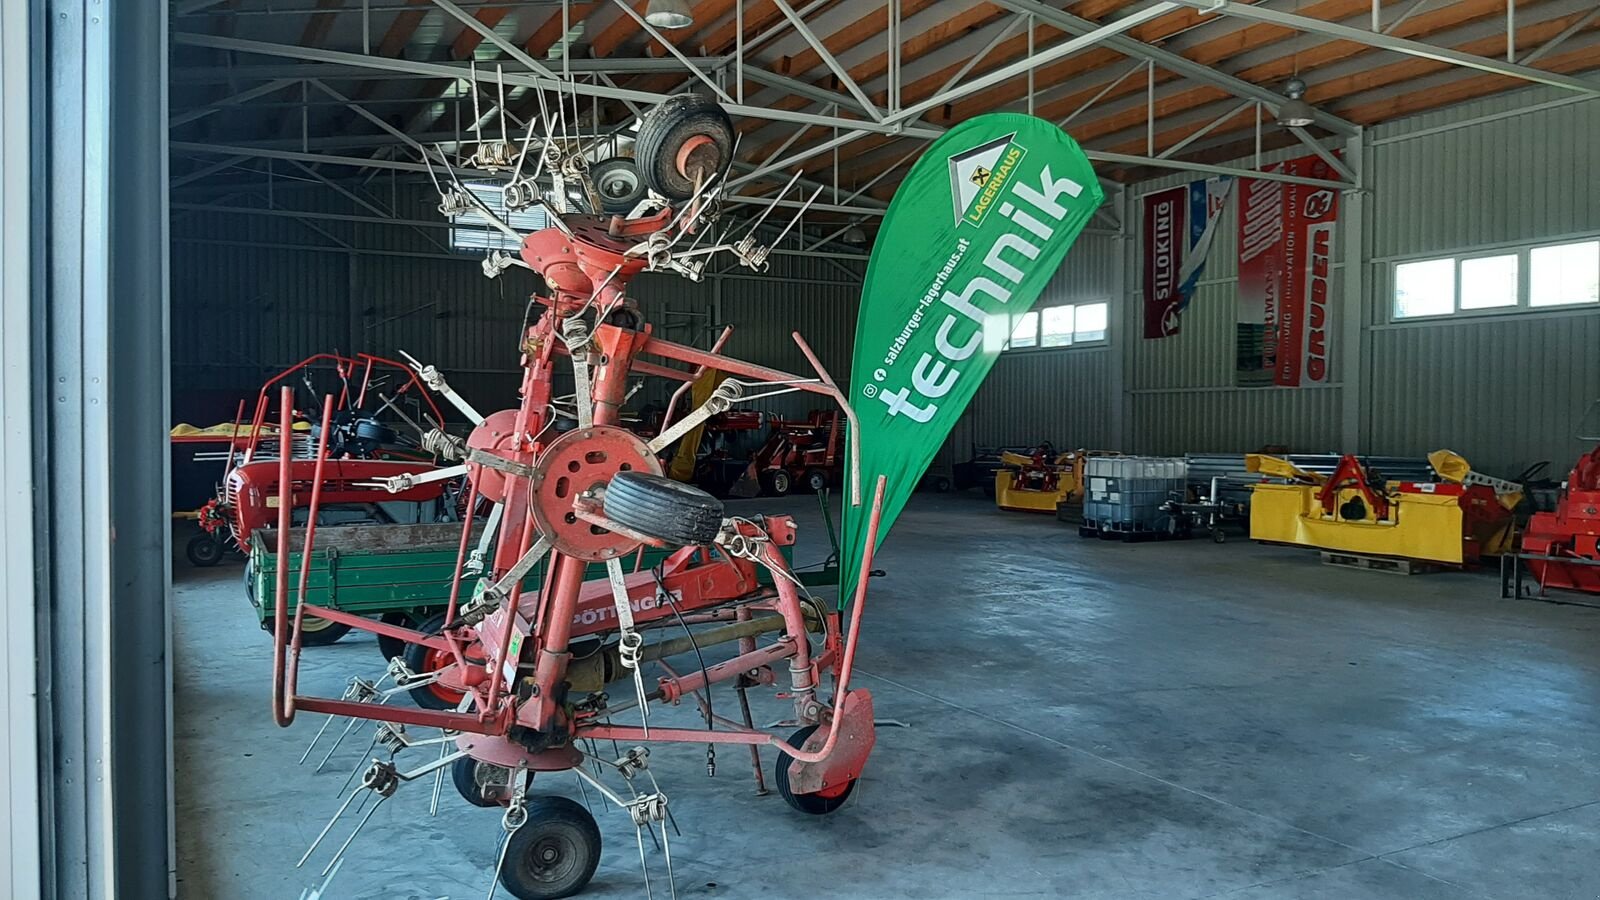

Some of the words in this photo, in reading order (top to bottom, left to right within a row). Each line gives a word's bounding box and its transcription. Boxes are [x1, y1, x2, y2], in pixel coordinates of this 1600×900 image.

[969, 148, 1021, 221] LAGERHAUS
[1288, 163, 1297, 218] QUALIT
[878, 163, 1084, 423] technik
[1156, 201, 1170, 300] SILOKING
[884, 237, 971, 366] salzburger-lagerhaus.at
[1307, 229, 1330, 381] GRUBER
[573, 588, 683, 625] ÖTTNGR
